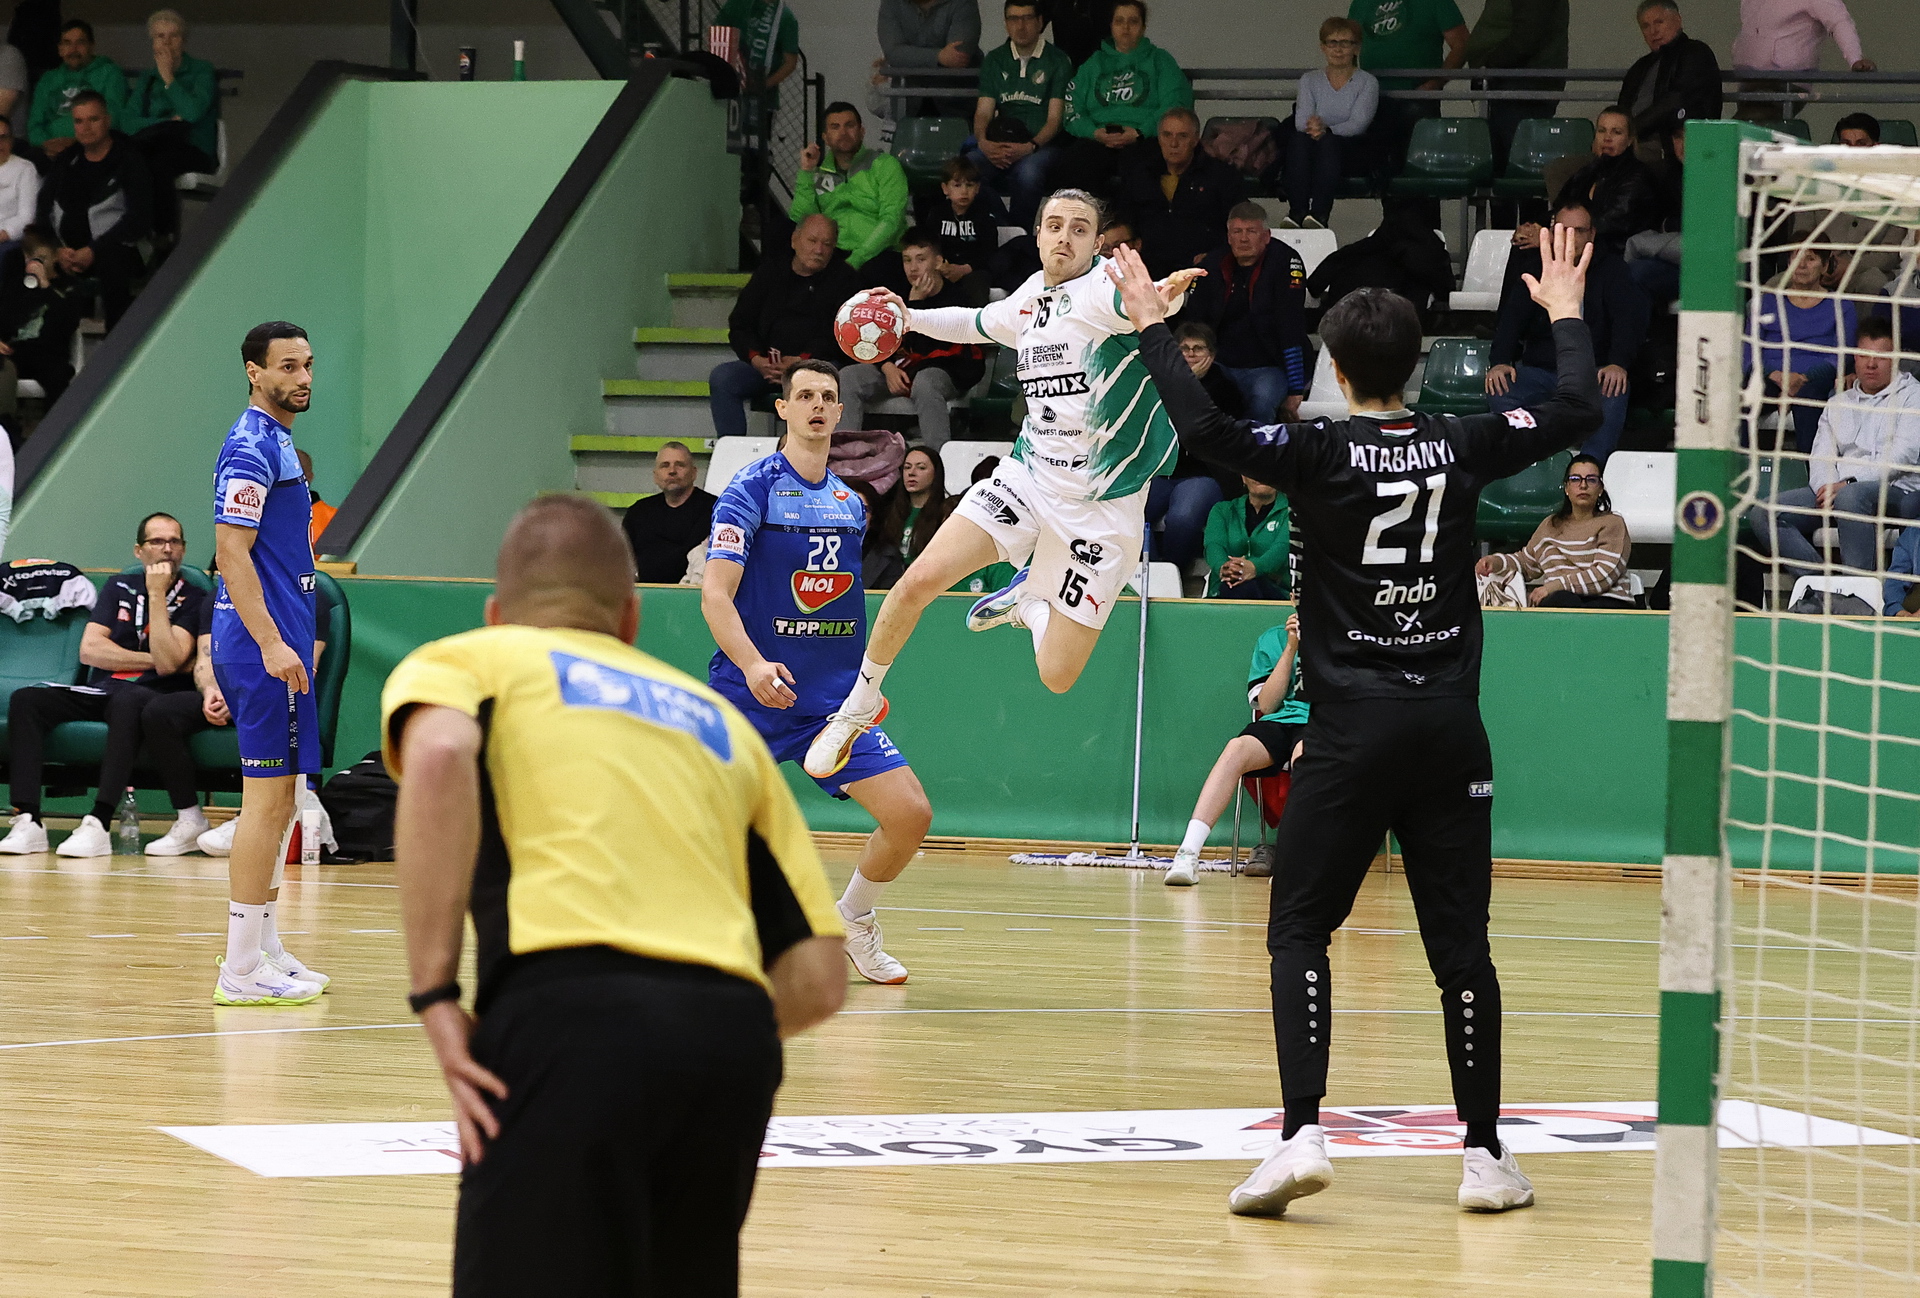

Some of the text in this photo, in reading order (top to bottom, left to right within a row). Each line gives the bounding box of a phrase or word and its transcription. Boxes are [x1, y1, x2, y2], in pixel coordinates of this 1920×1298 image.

[959, 220, 976, 236] KIEL
[852, 307, 895, 326] SELECT
[1033, 296, 1053, 328] 15
[1032, 342, 1069, 355] SZÉCHENYI
[1032, 352, 1063, 364] EGYETEM
[1694, 337, 1710, 424] elan
[1058, 429, 1083, 437] GROUP
[238, 493, 259, 508] VITA
[784, 511, 800, 520] JAKO
[1361, 472, 1447, 565] 21
[720, 533, 738, 543] VITA
[805, 535, 842, 571] 28
[799, 576, 835, 593] MOL
[1058, 567, 1089, 608] 15
[775, 620, 856, 635] TiPPMIX
[1347, 626, 1461, 646] GRUNDFOS
[875, 731, 894, 749] 28
